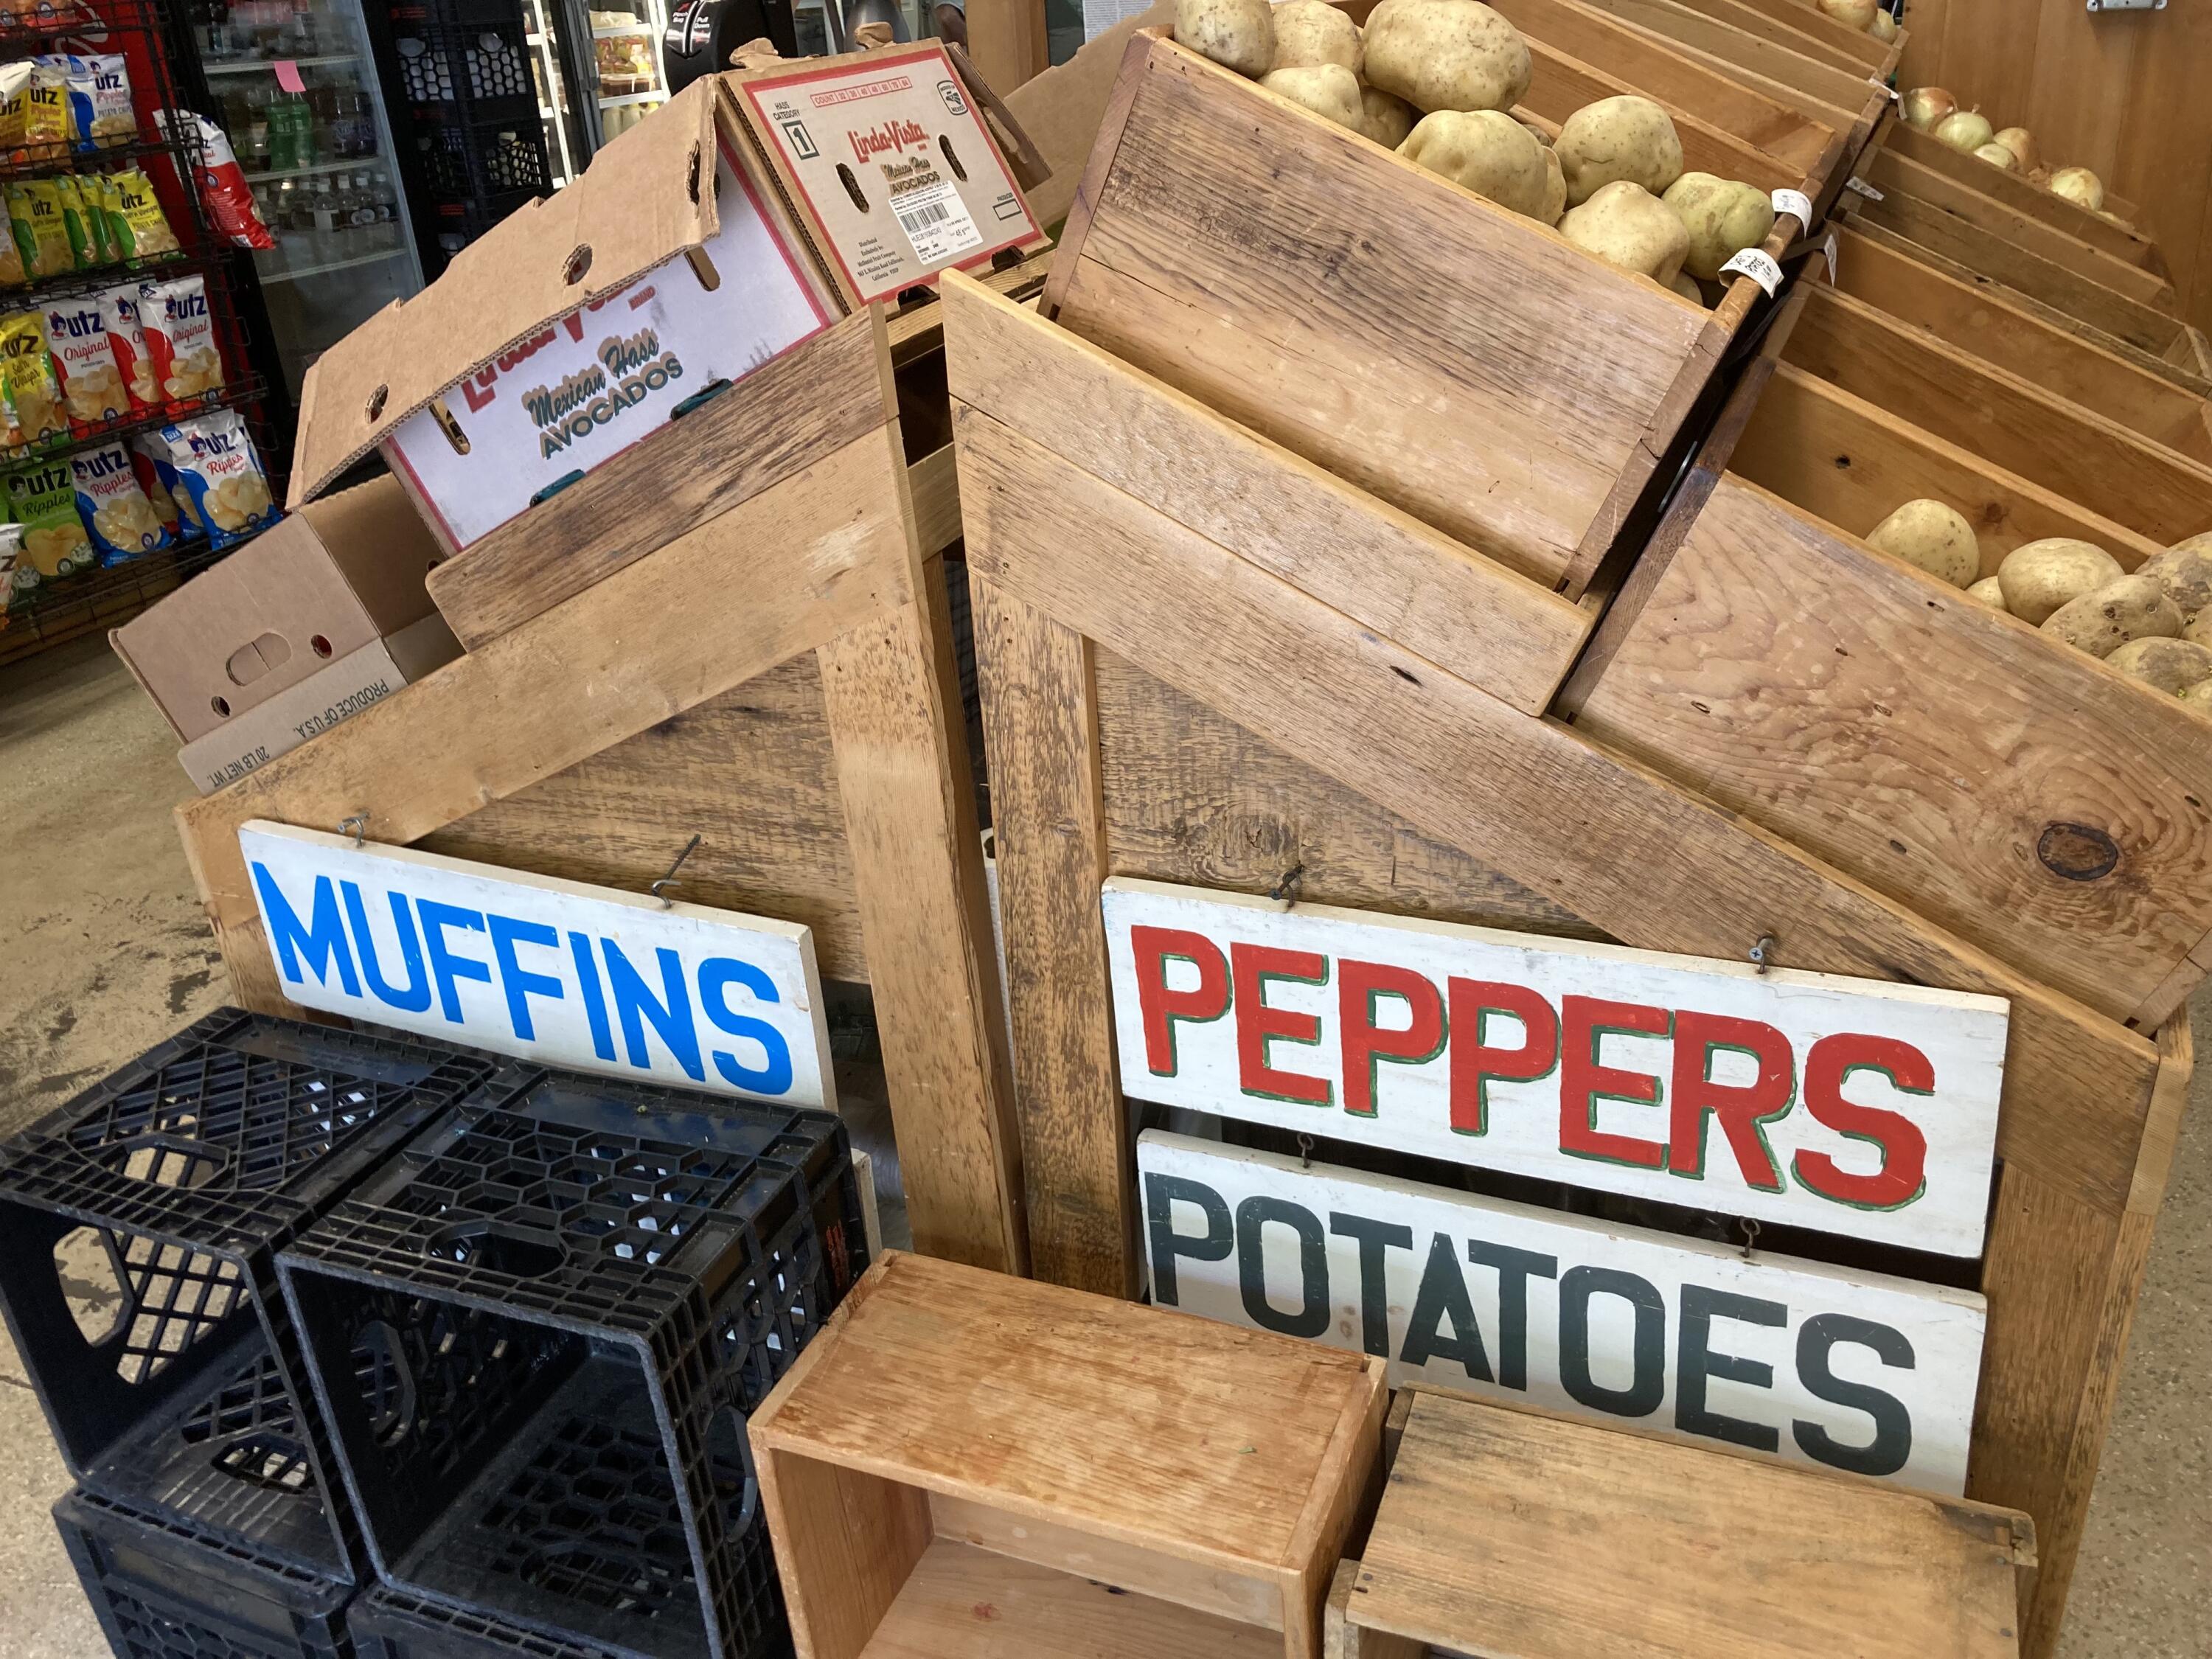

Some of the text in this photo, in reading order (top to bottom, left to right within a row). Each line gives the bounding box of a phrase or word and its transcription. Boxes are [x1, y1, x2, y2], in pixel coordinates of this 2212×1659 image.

[95, 73, 122, 90] utz
[30, 87, 58, 105] utz
[775, 101, 790, 109] HASS
[814, 94, 836, 105] COUNT
[773, 110, 801, 121] CATEGORY
[793, 128, 811, 152] 1
[891, 170, 941, 195] AVOCADOS
[31, 198, 54, 217] utz
[122, 193, 147, 209] utz
[176, 293, 207, 320] utz
[66, 310, 105, 338] utz
[173, 319, 209, 344] Original
[4, 332, 39, 358] utz
[63, 336, 110, 361] Original
[524, 332, 660, 428] Mexican Hass
[540, 357, 684, 461] AVOCADOS
[88, 449, 131, 479] utz
[26, 466, 71, 496] utz
[90, 471, 133, 497] Ripples
[22, 493, 72, 516] Ripples
[293, 679, 391, 739] PRODUCE OF U.S.A.
[206, 745, 271, 788] 20 LB NET WT.
[250, 860, 794, 1096] MUFFINS
[1130, 923, 1937, 1213] PEPPERS
[1143, 1170, 1917, 1477] POTATOES
